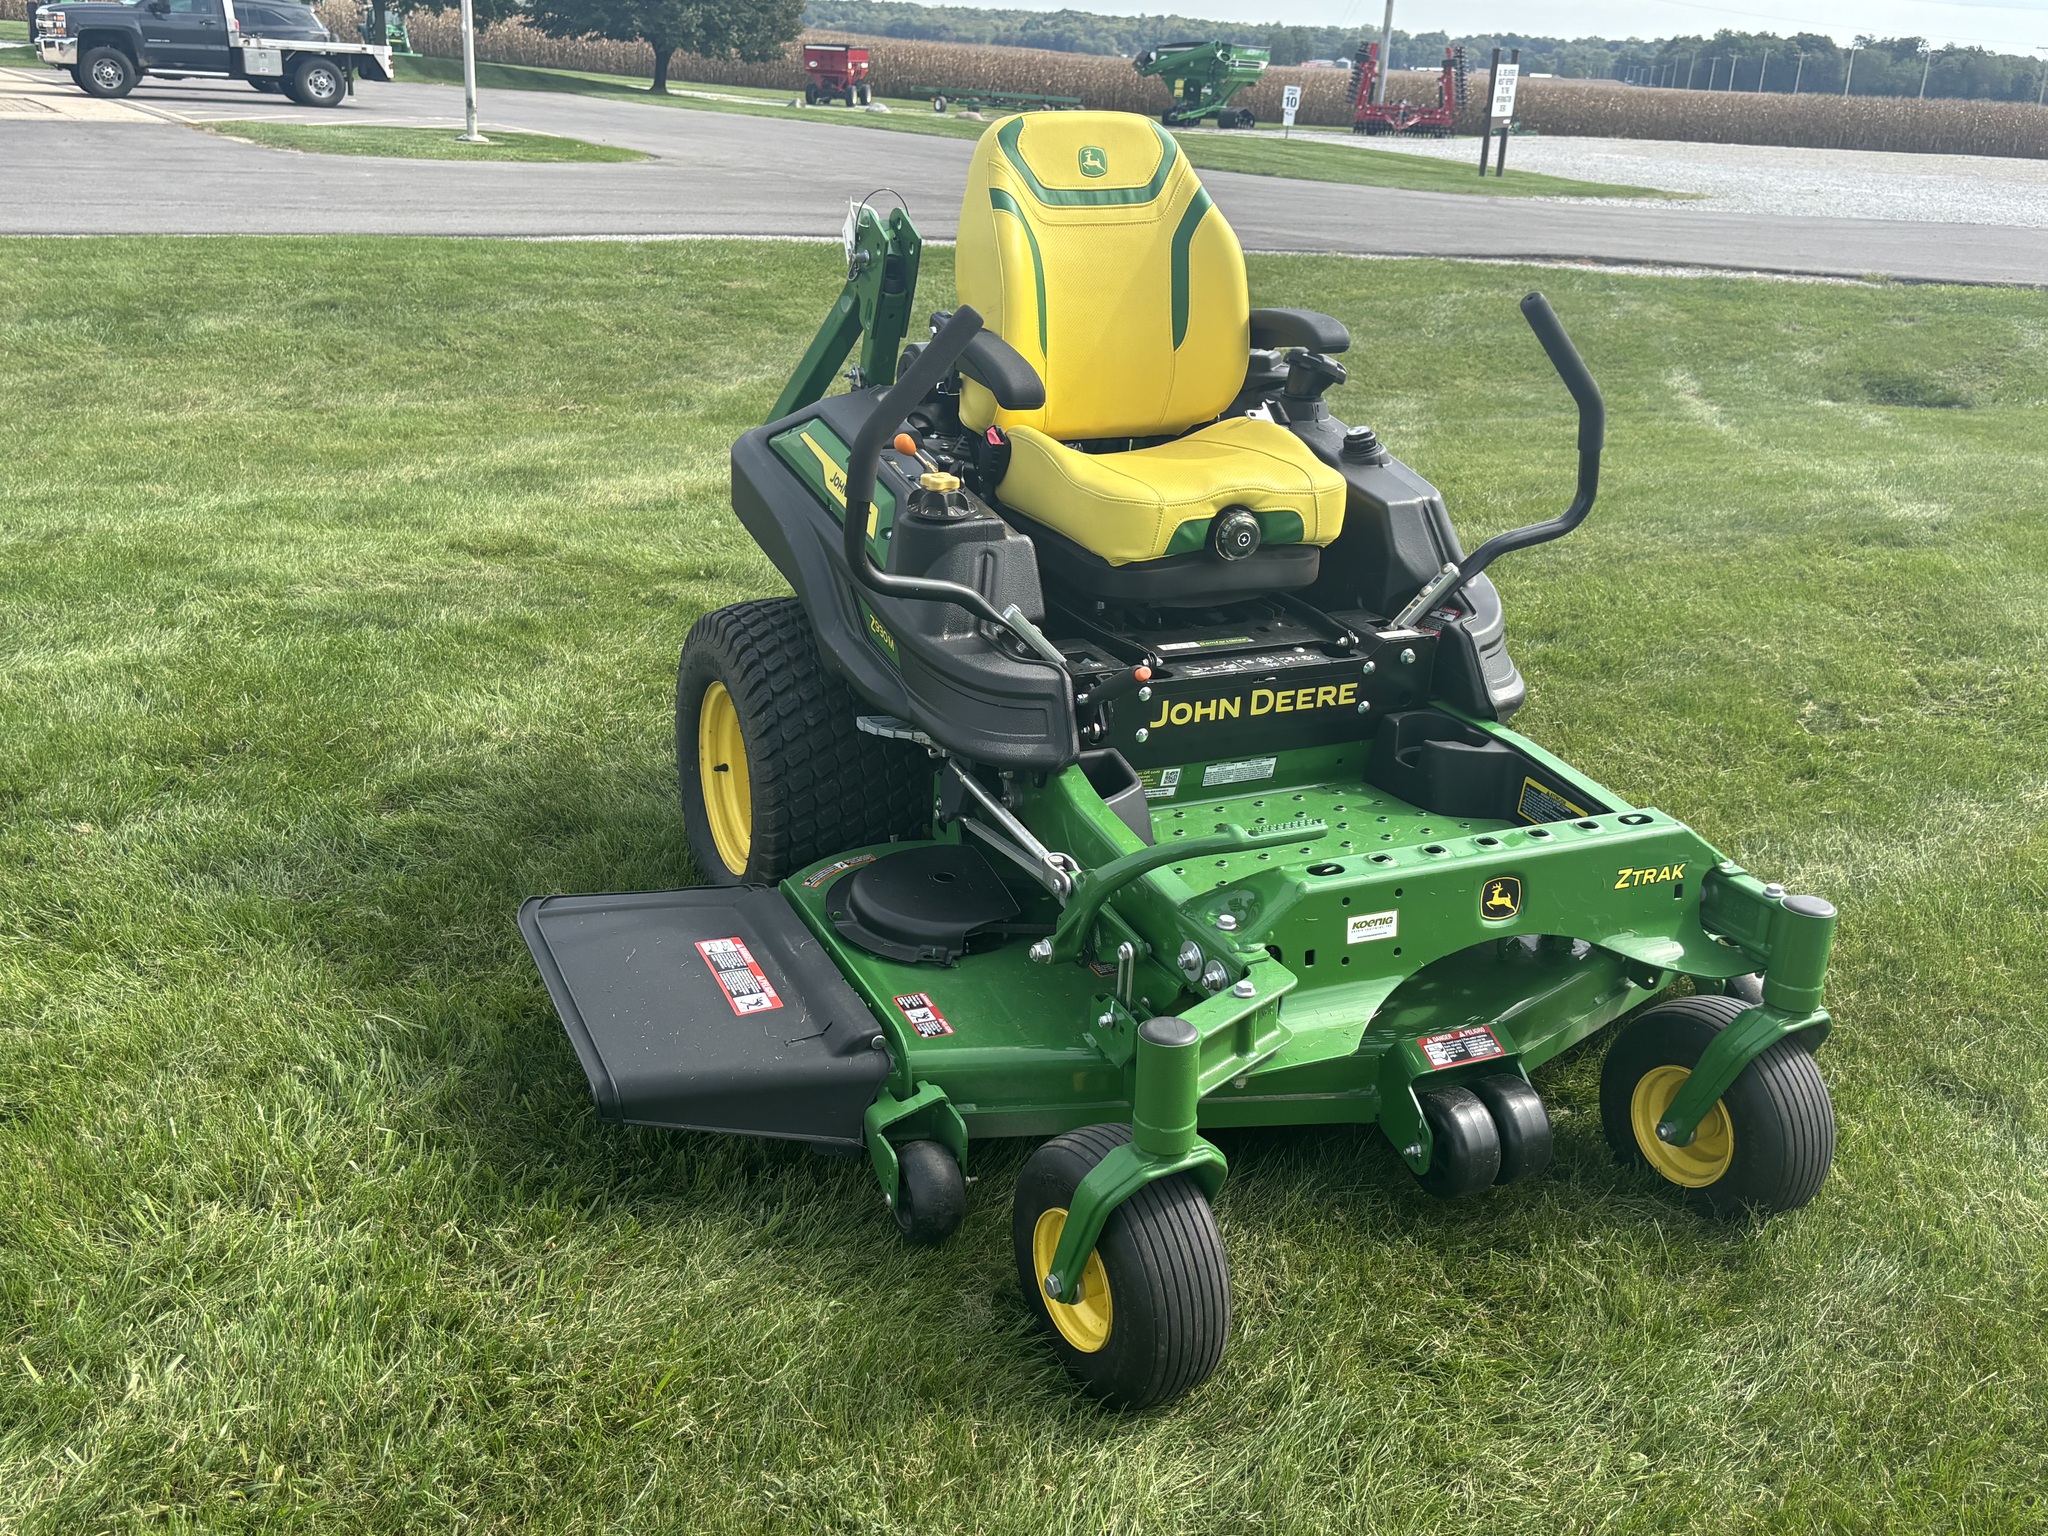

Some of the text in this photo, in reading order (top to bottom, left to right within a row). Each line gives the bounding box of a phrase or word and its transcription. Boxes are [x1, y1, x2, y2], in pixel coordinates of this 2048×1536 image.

[1285, 96, 1297, 108] 10
[1150, 682, 1358, 729] JOHN DEERE
[1614, 862, 1687, 890] ZTRAK
